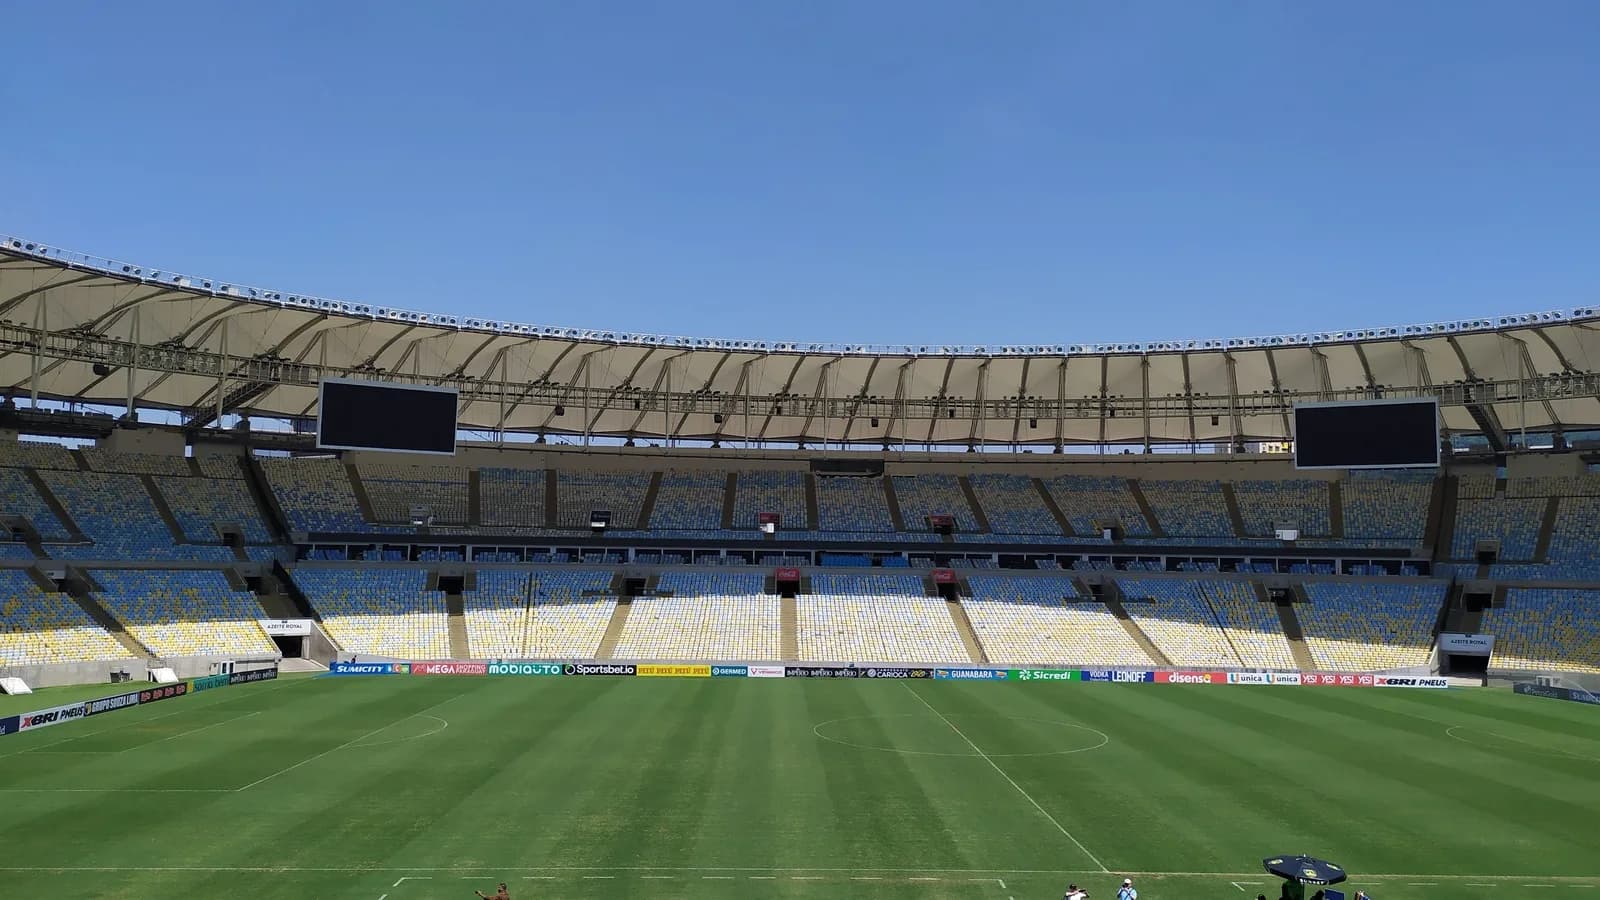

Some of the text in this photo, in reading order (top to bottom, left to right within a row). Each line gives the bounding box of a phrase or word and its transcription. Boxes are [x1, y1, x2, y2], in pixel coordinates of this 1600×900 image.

[337, 665, 384, 673] SUMICITY
[426, 664, 455, 674] MEGA
[576, 664, 634, 675] Sportsbet.io
[951, 670, 993, 678] GUANABARA
[1033, 671, 1071, 680] Sicredi
[1112, 671, 1147, 683] LEONOFF
[1168, 671, 1211, 684] disensa
[92, 701, 109, 713] GRUPO
[110, 696, 126, 709] SOUZA
[60, 706, 84, 720] PNEUS
